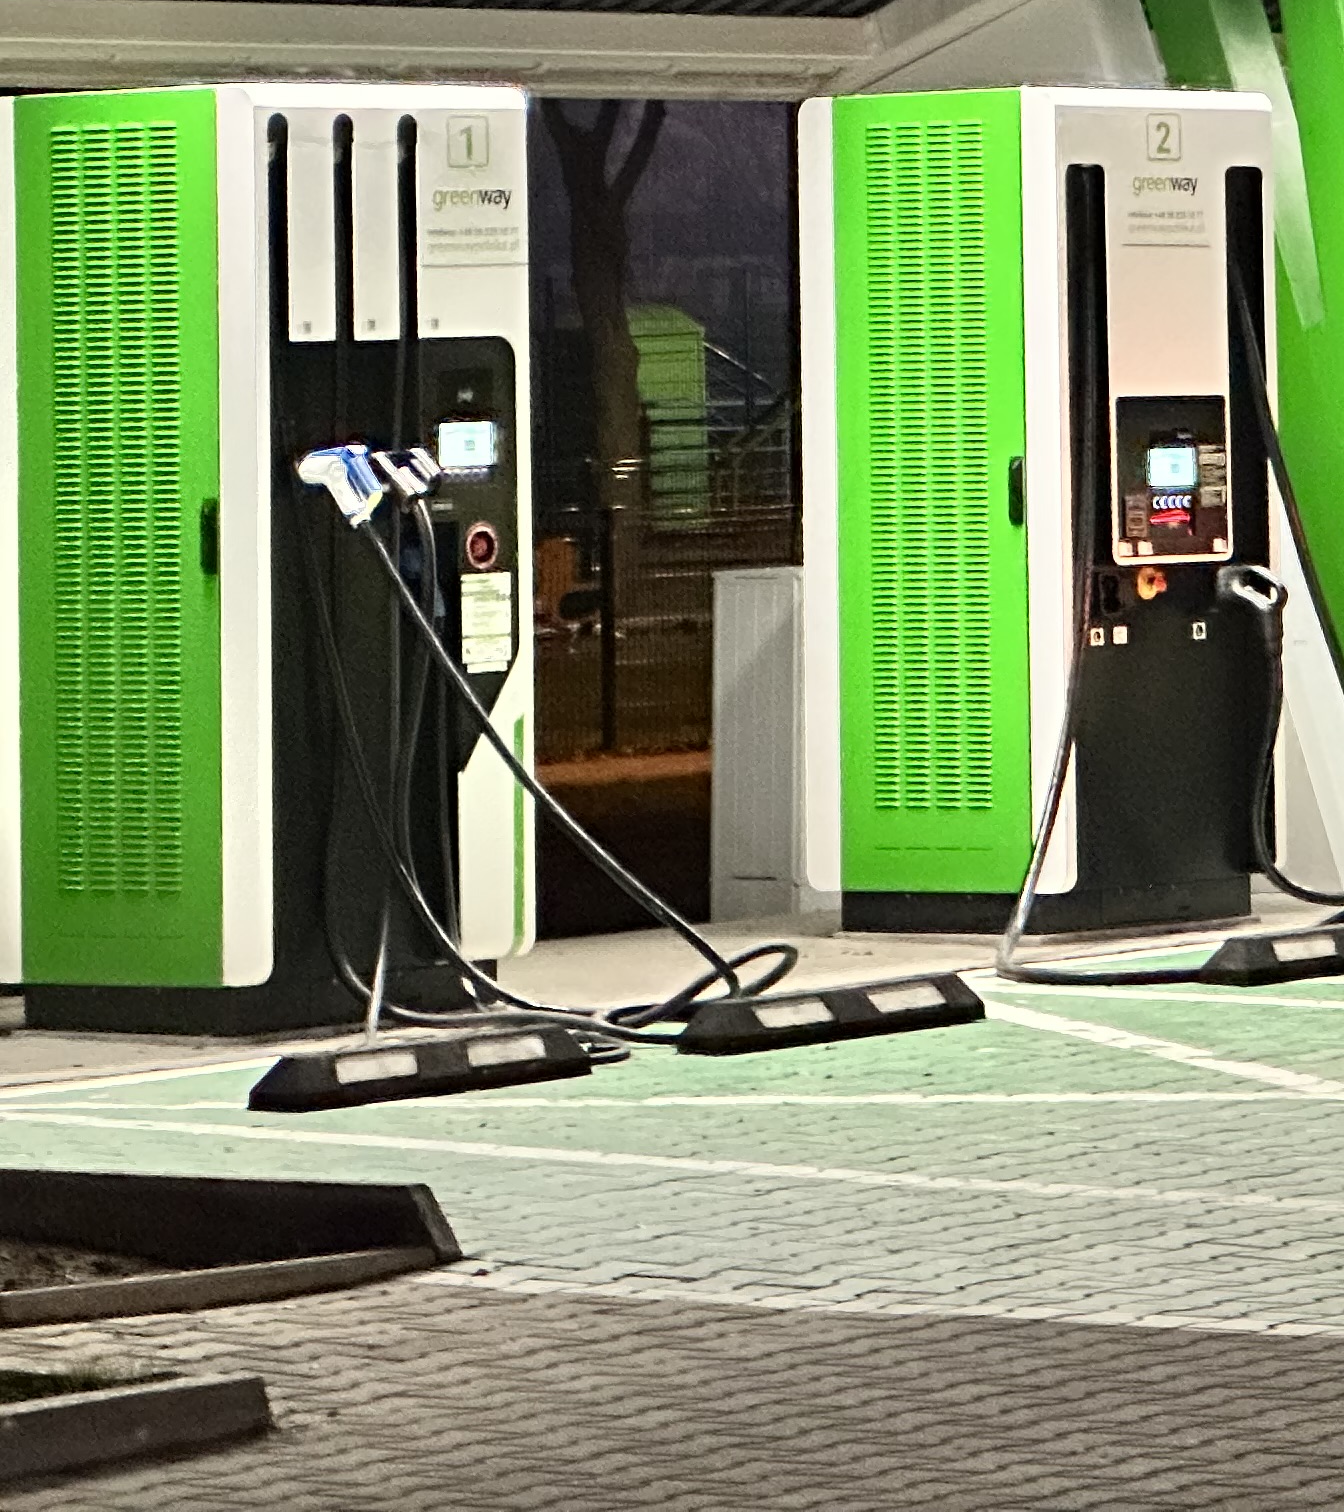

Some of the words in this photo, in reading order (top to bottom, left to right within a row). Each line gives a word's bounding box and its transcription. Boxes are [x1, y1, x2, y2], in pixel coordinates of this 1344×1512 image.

[459, 124, 473, 161] 1
[1155, 121, 1171, 155] 2
[1132, 176, 1198, 196] greenway
[432, 189, 512, 212] greenway
